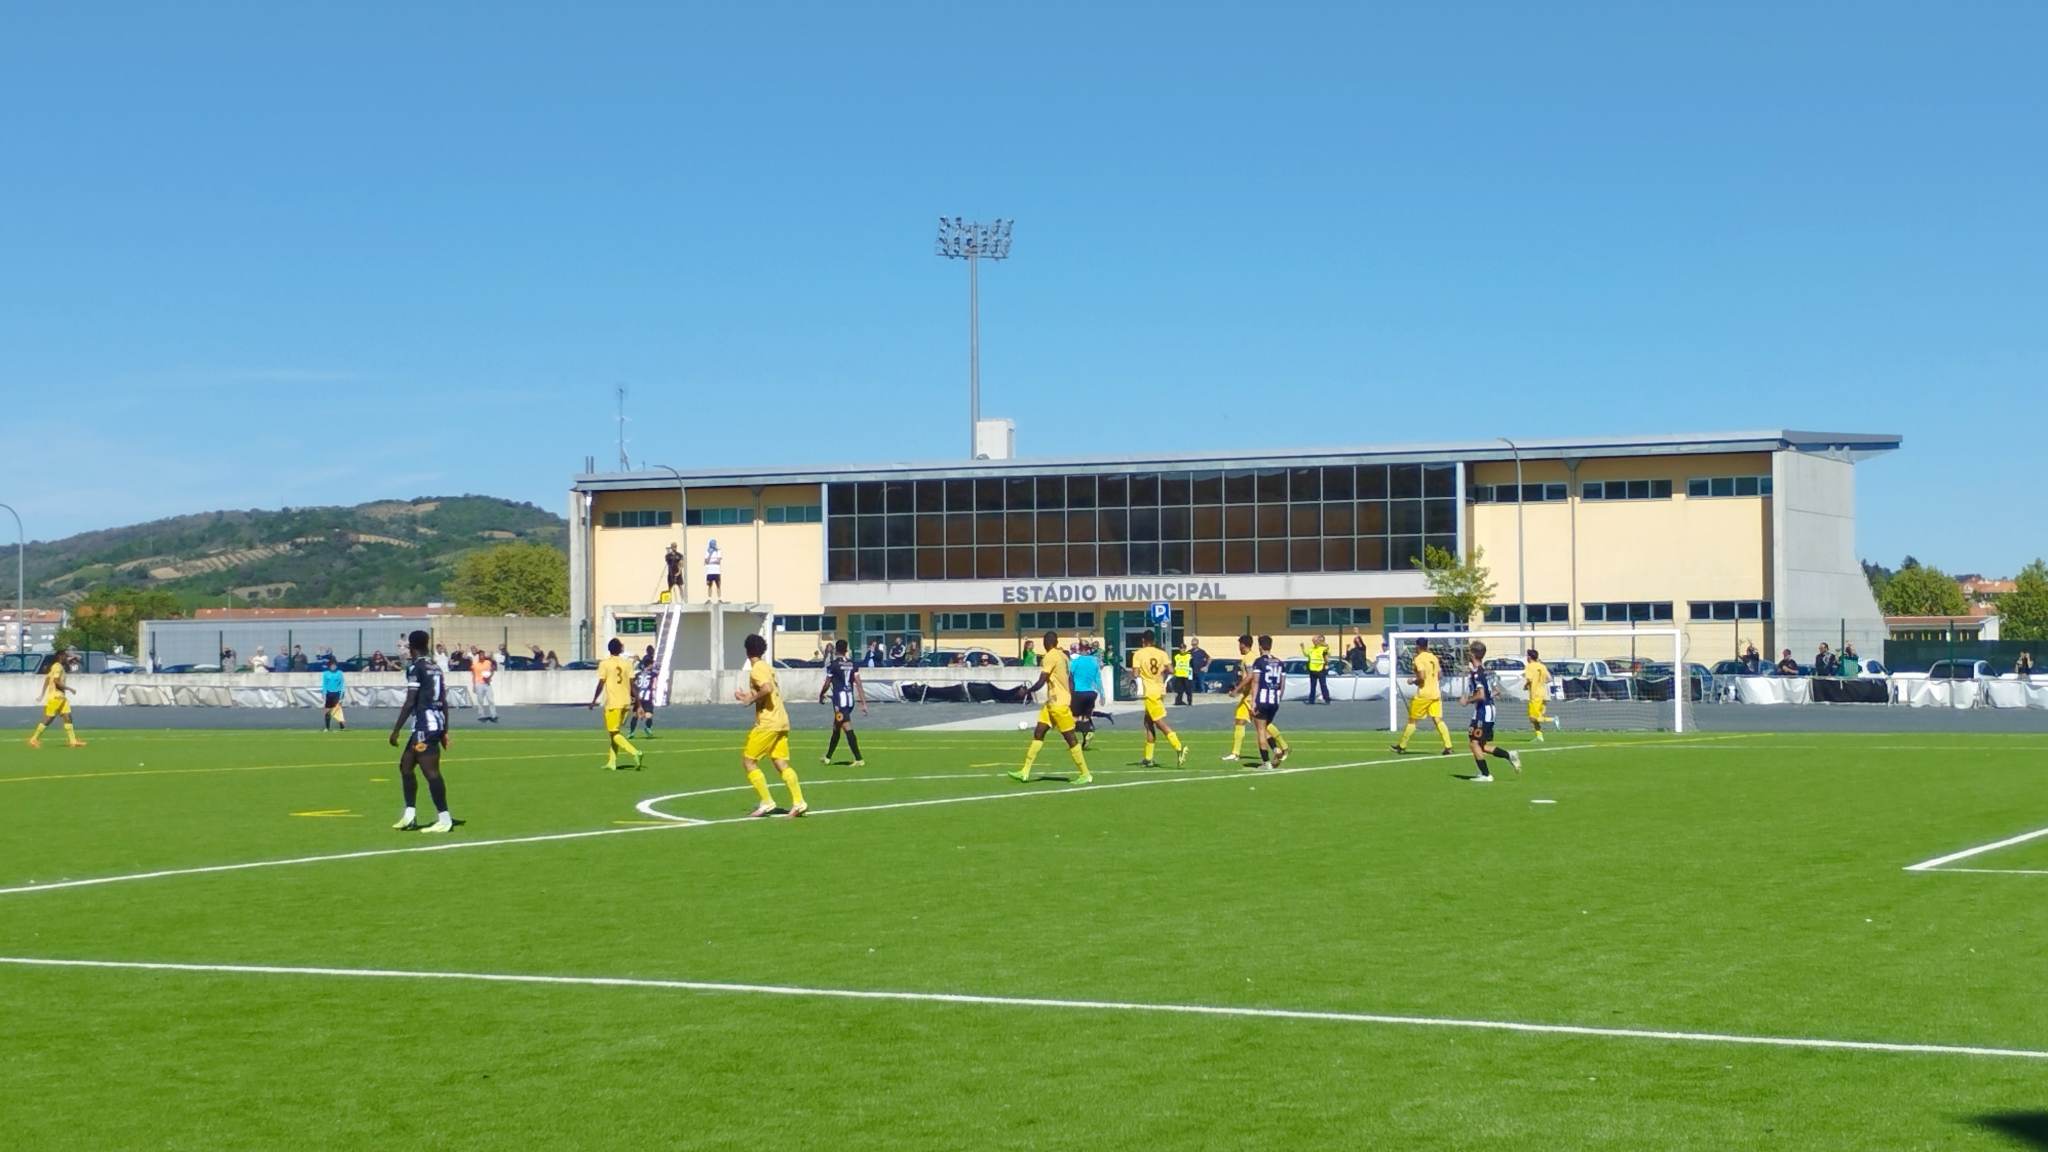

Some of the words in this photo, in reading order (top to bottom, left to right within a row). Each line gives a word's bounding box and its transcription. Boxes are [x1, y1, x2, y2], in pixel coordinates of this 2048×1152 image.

[1002, 582, 1097, 602] ESTÁDIO
[1104, 582, 1227, 601] MUNICIPAL
[1155, 604, 1167, 618] P
[616, 666, 623, 685] 3
[1150, 658, 1159, 675] 8
[1264, 665, 1283, 683] 24
